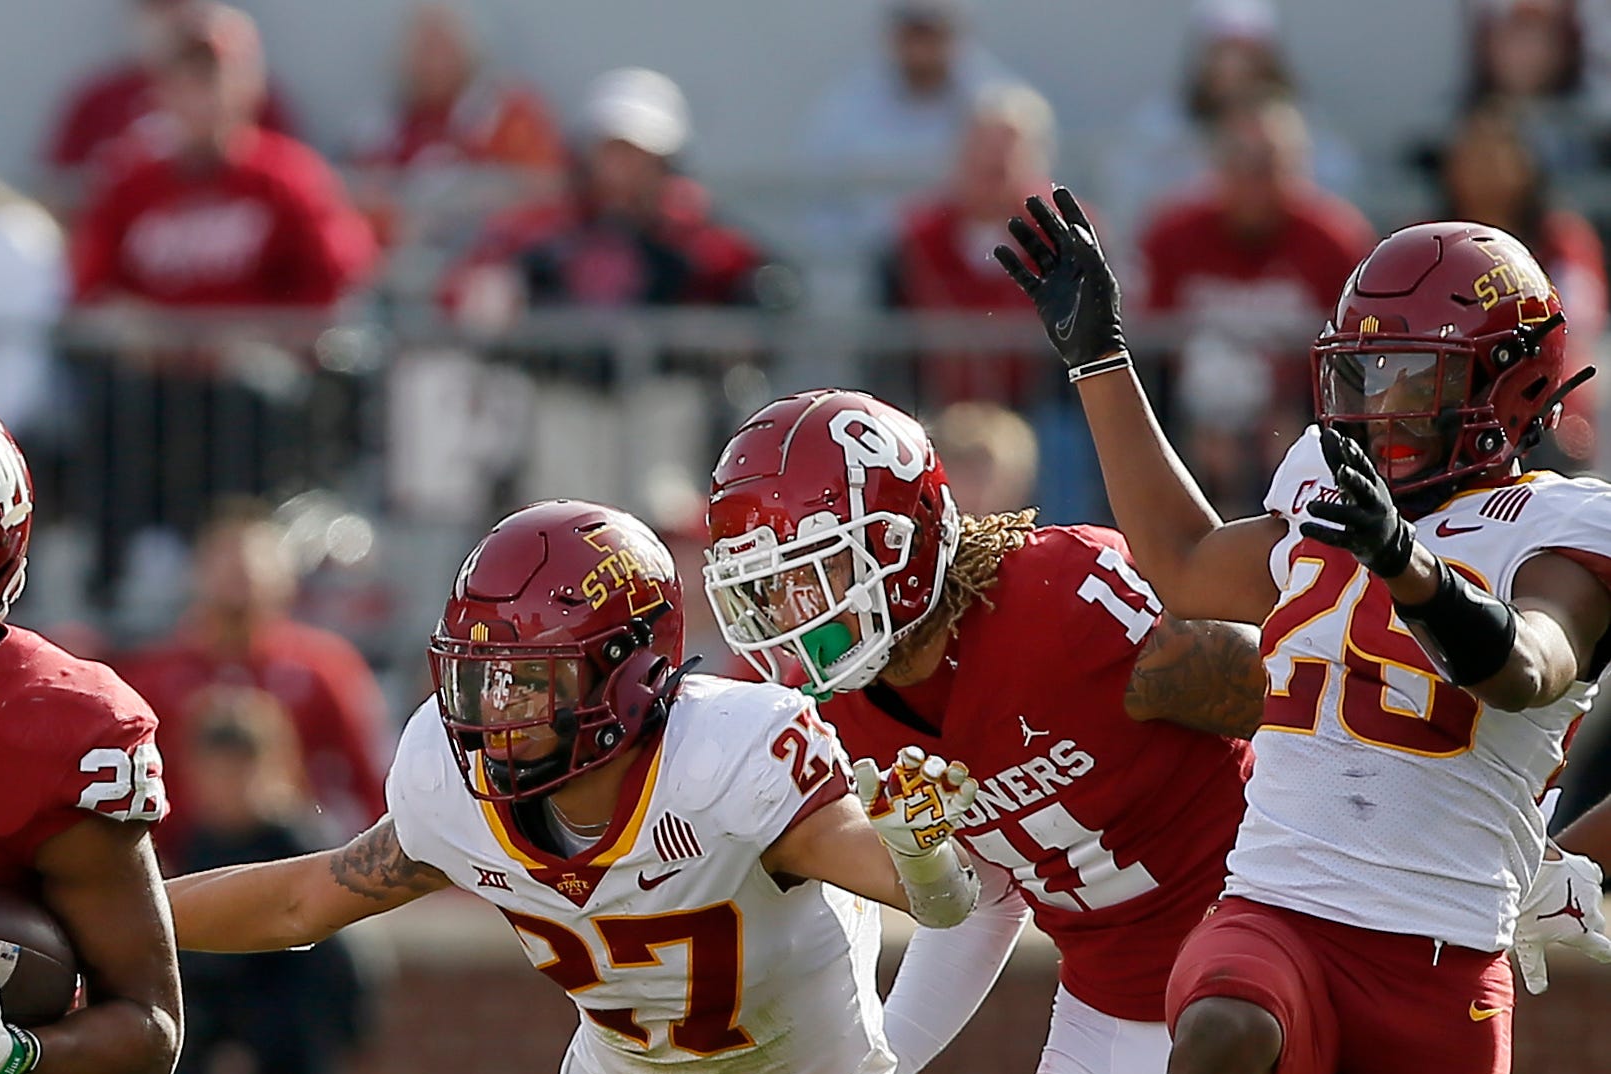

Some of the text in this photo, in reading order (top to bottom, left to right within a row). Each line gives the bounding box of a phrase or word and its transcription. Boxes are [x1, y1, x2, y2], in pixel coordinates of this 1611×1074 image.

[828, 409, 927, 482] OU
[1292, 478, 1318, 515] C
[1076, 545, 1164, 645] 11
[75, 743, 165, 823] 26
[771, 707, 834, 796] 27
[471, 864, 514, 893] XII
[556, 879, 590, 892] STATE
[964, 801, 1160, 912] 11
[496, 899, 757, 1056] 27
